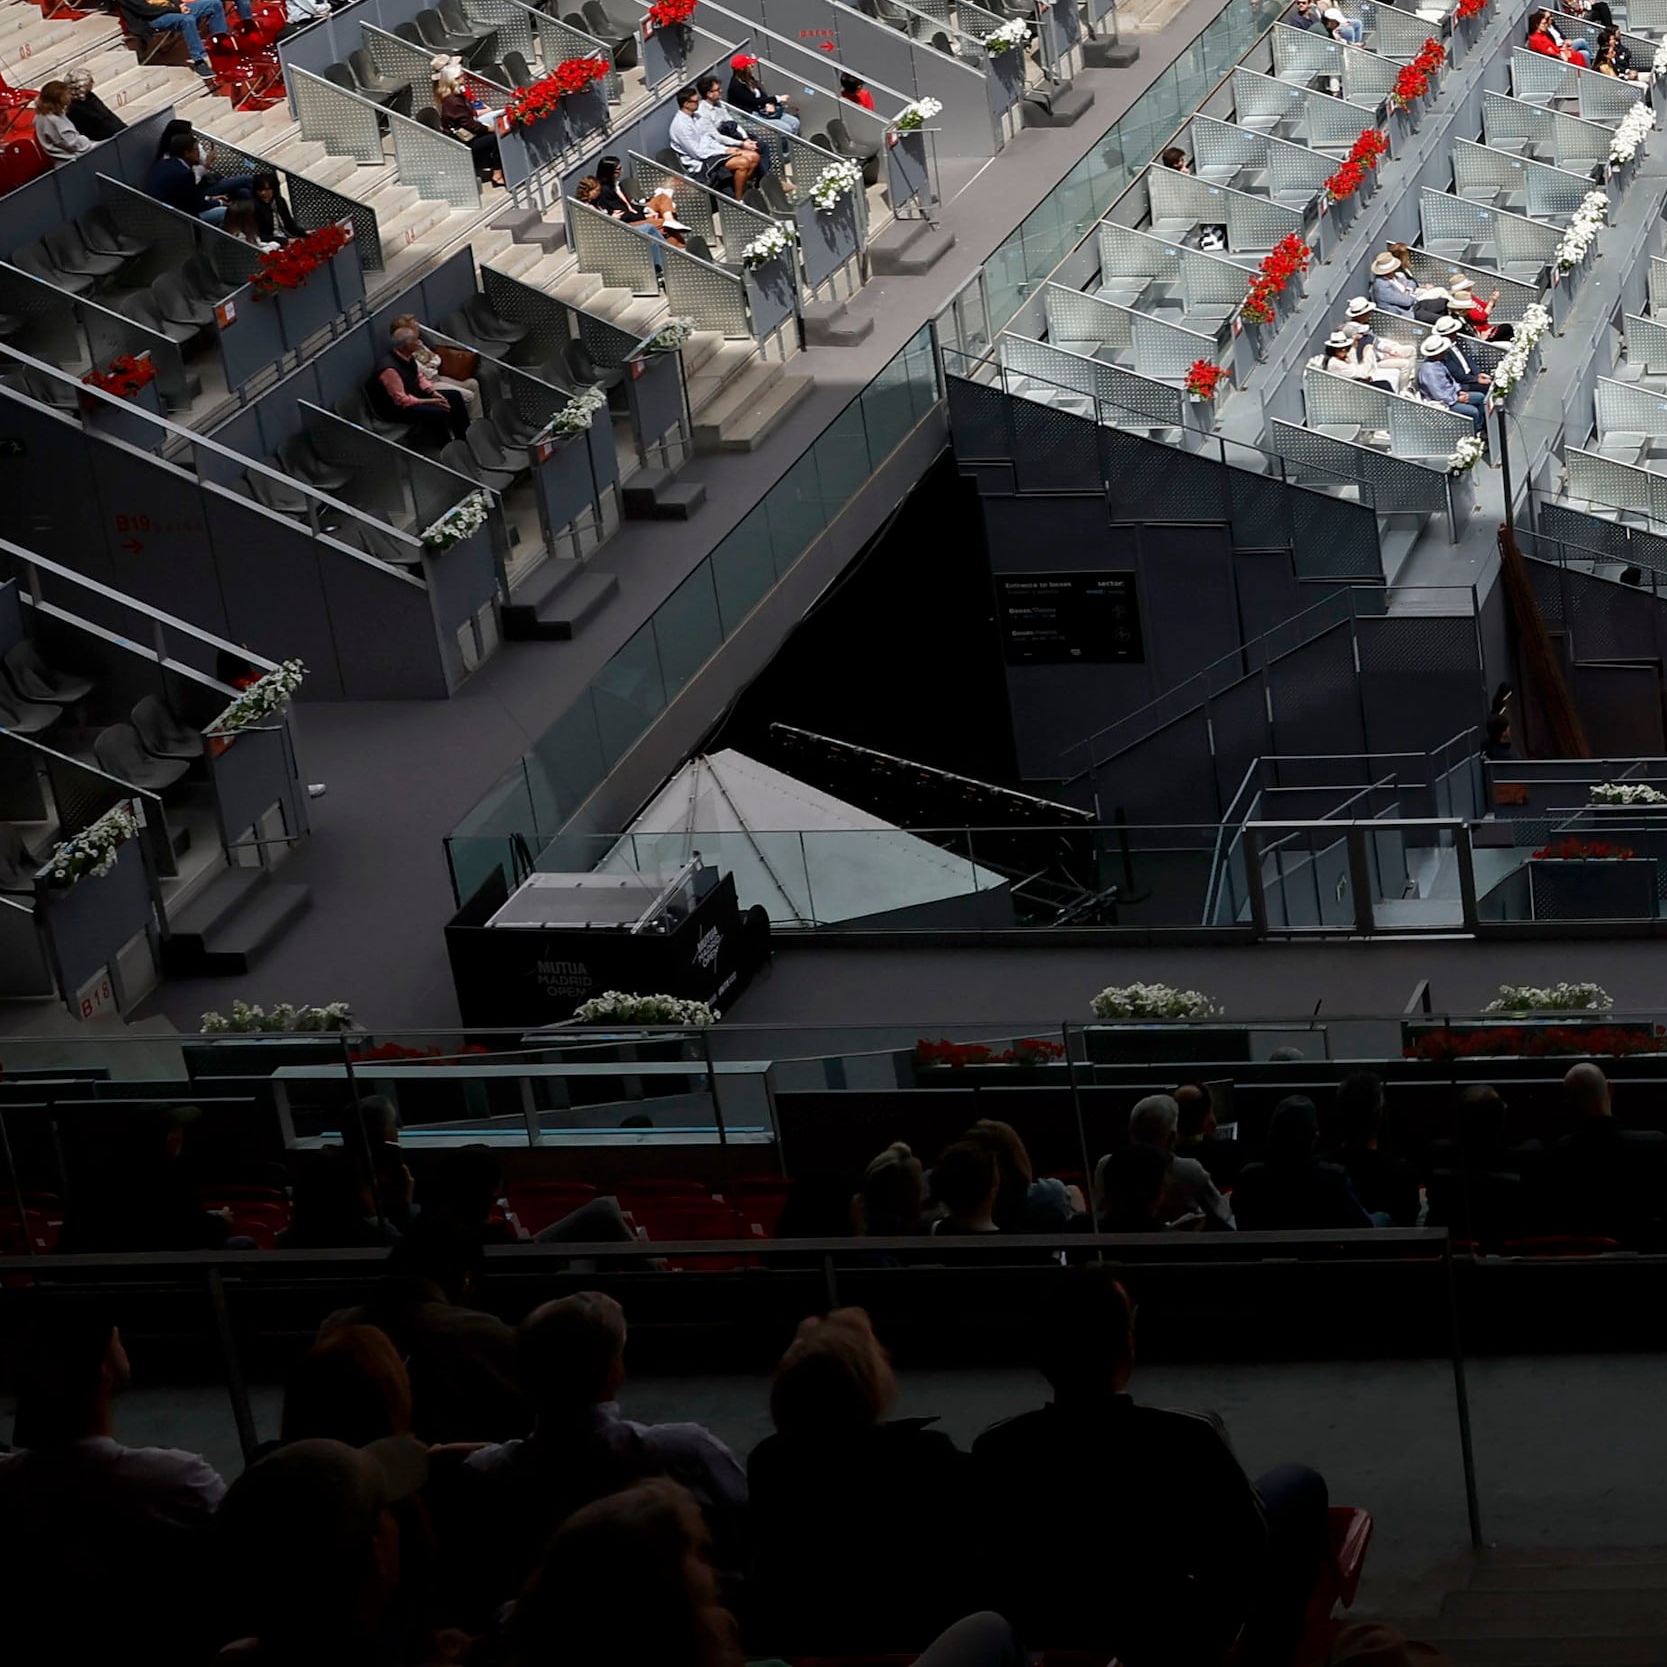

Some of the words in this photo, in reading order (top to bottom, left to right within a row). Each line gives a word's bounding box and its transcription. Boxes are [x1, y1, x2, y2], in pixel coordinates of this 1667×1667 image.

[537, 960, 588, 975] MUTUA
[536, 975, 592, 987] MADRID
[546, 985, 587, 997] OPEN
